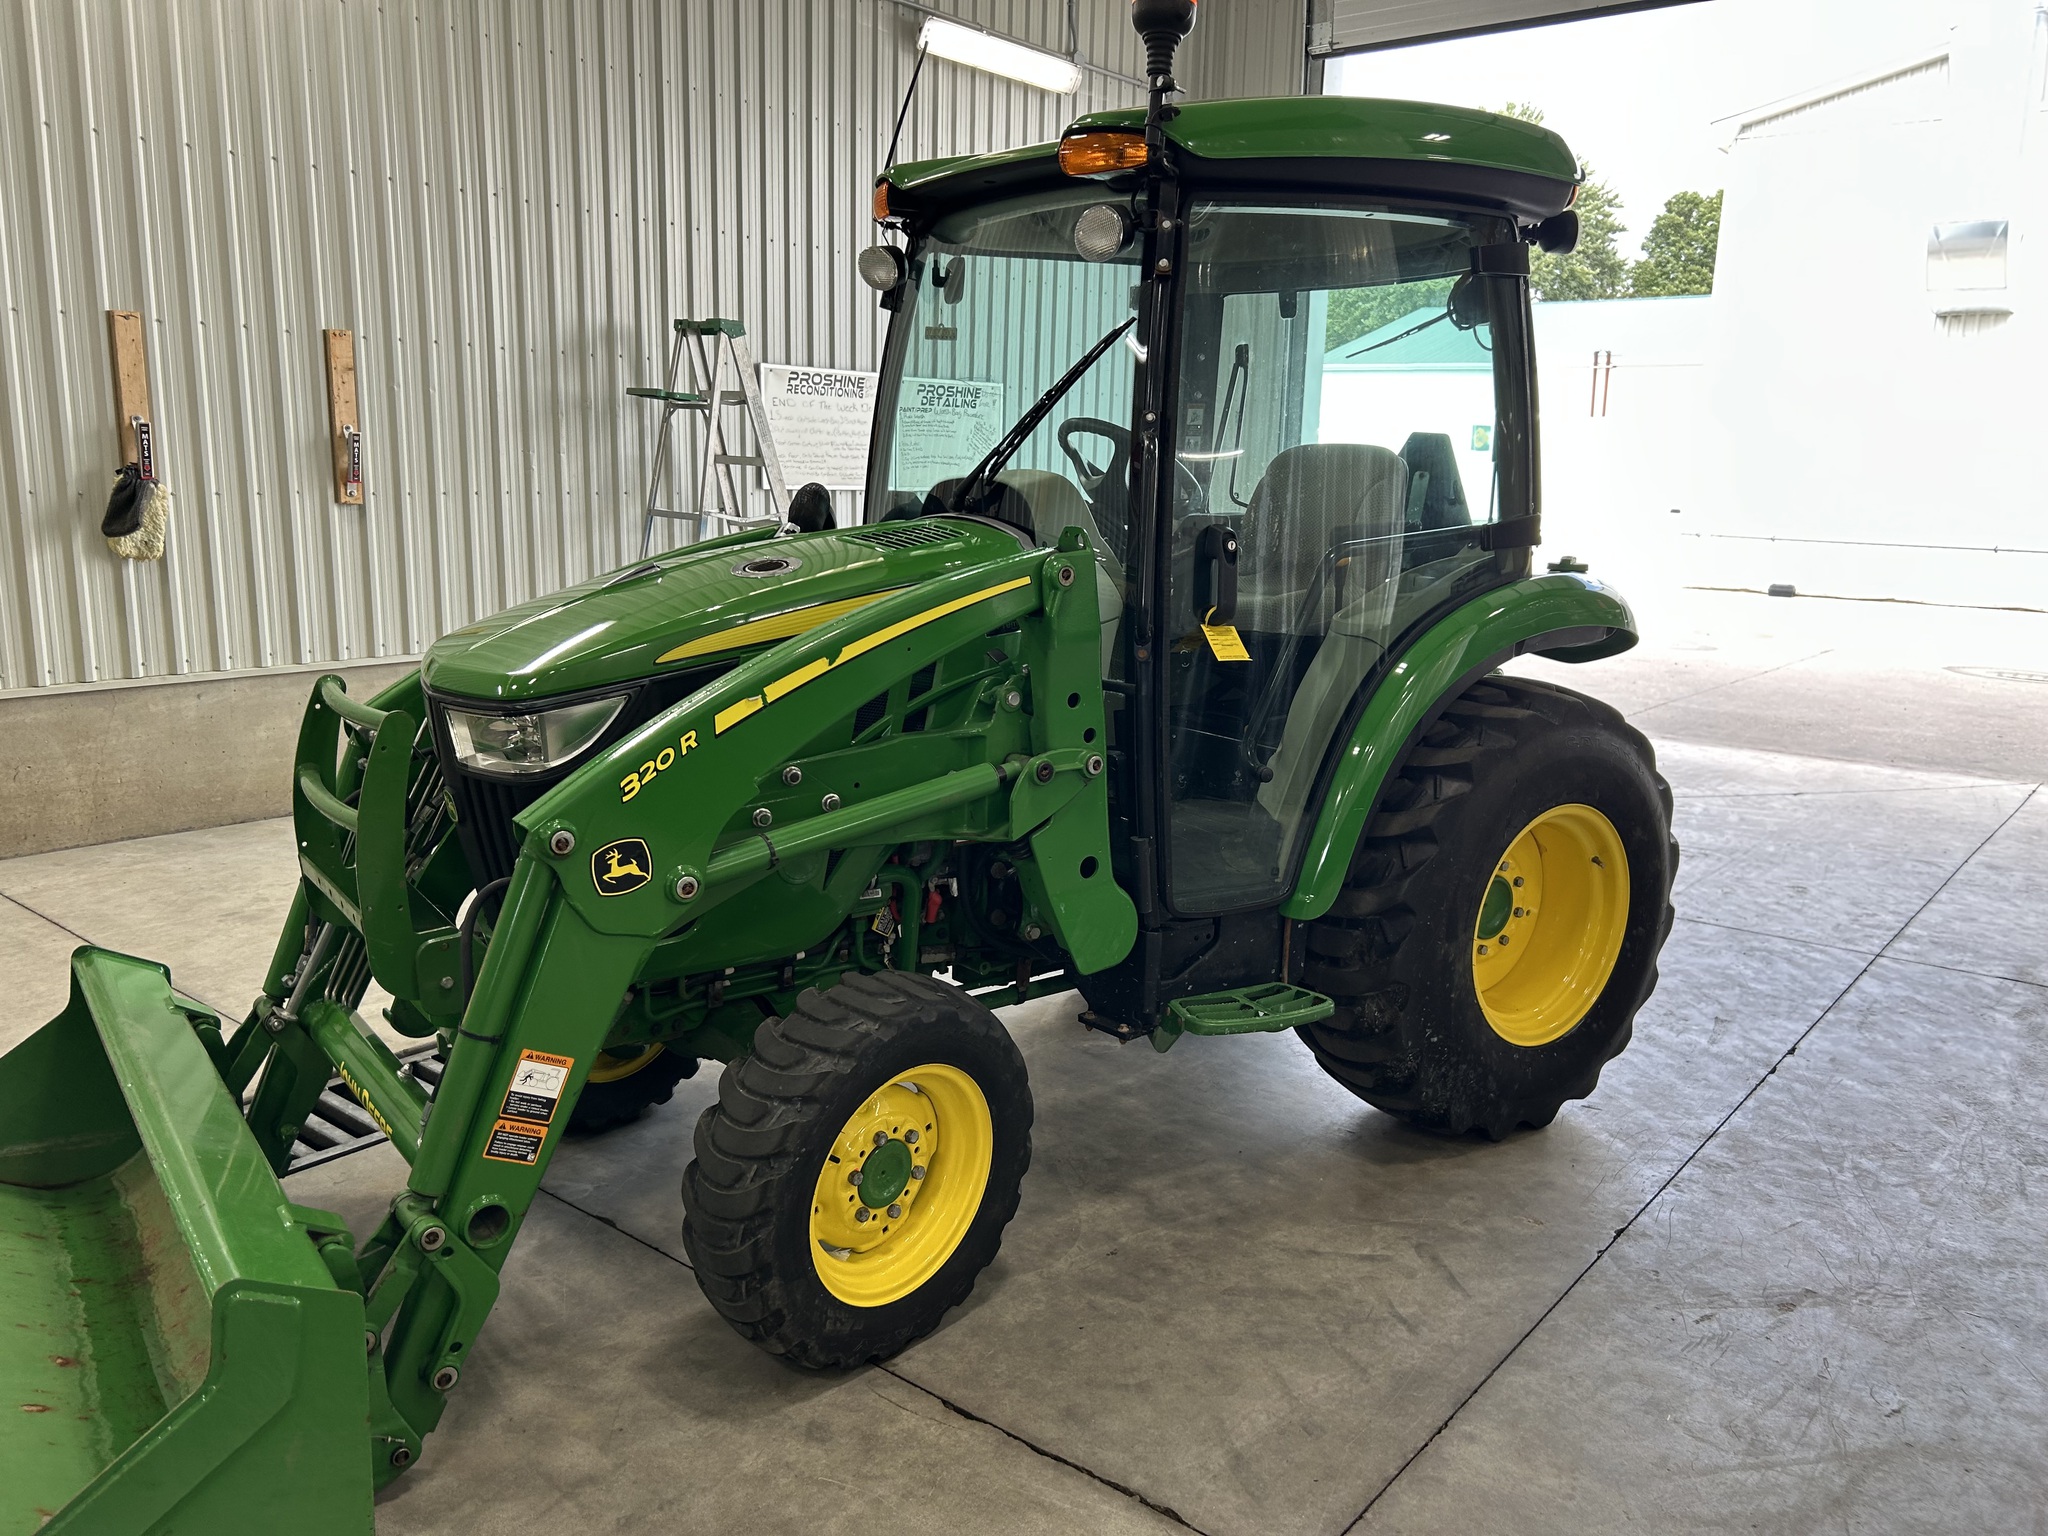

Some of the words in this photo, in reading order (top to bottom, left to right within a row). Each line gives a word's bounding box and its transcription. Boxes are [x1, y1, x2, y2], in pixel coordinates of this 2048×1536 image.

[788, 371, 866, 389] PROSHINE
[787, 384, 864, 399] RECONDITIONING
[917, 384, 982, 399] PROSHINE
[772, 397, 796, 407] END
[921, 396, 977, 409] DETAILING
[620, 747, 676, 803] 320
[679, 730, 699, 756] R
[535, 1053, 567, 1066] WARNING
[509, 1124, 541, 1135] WARNING
